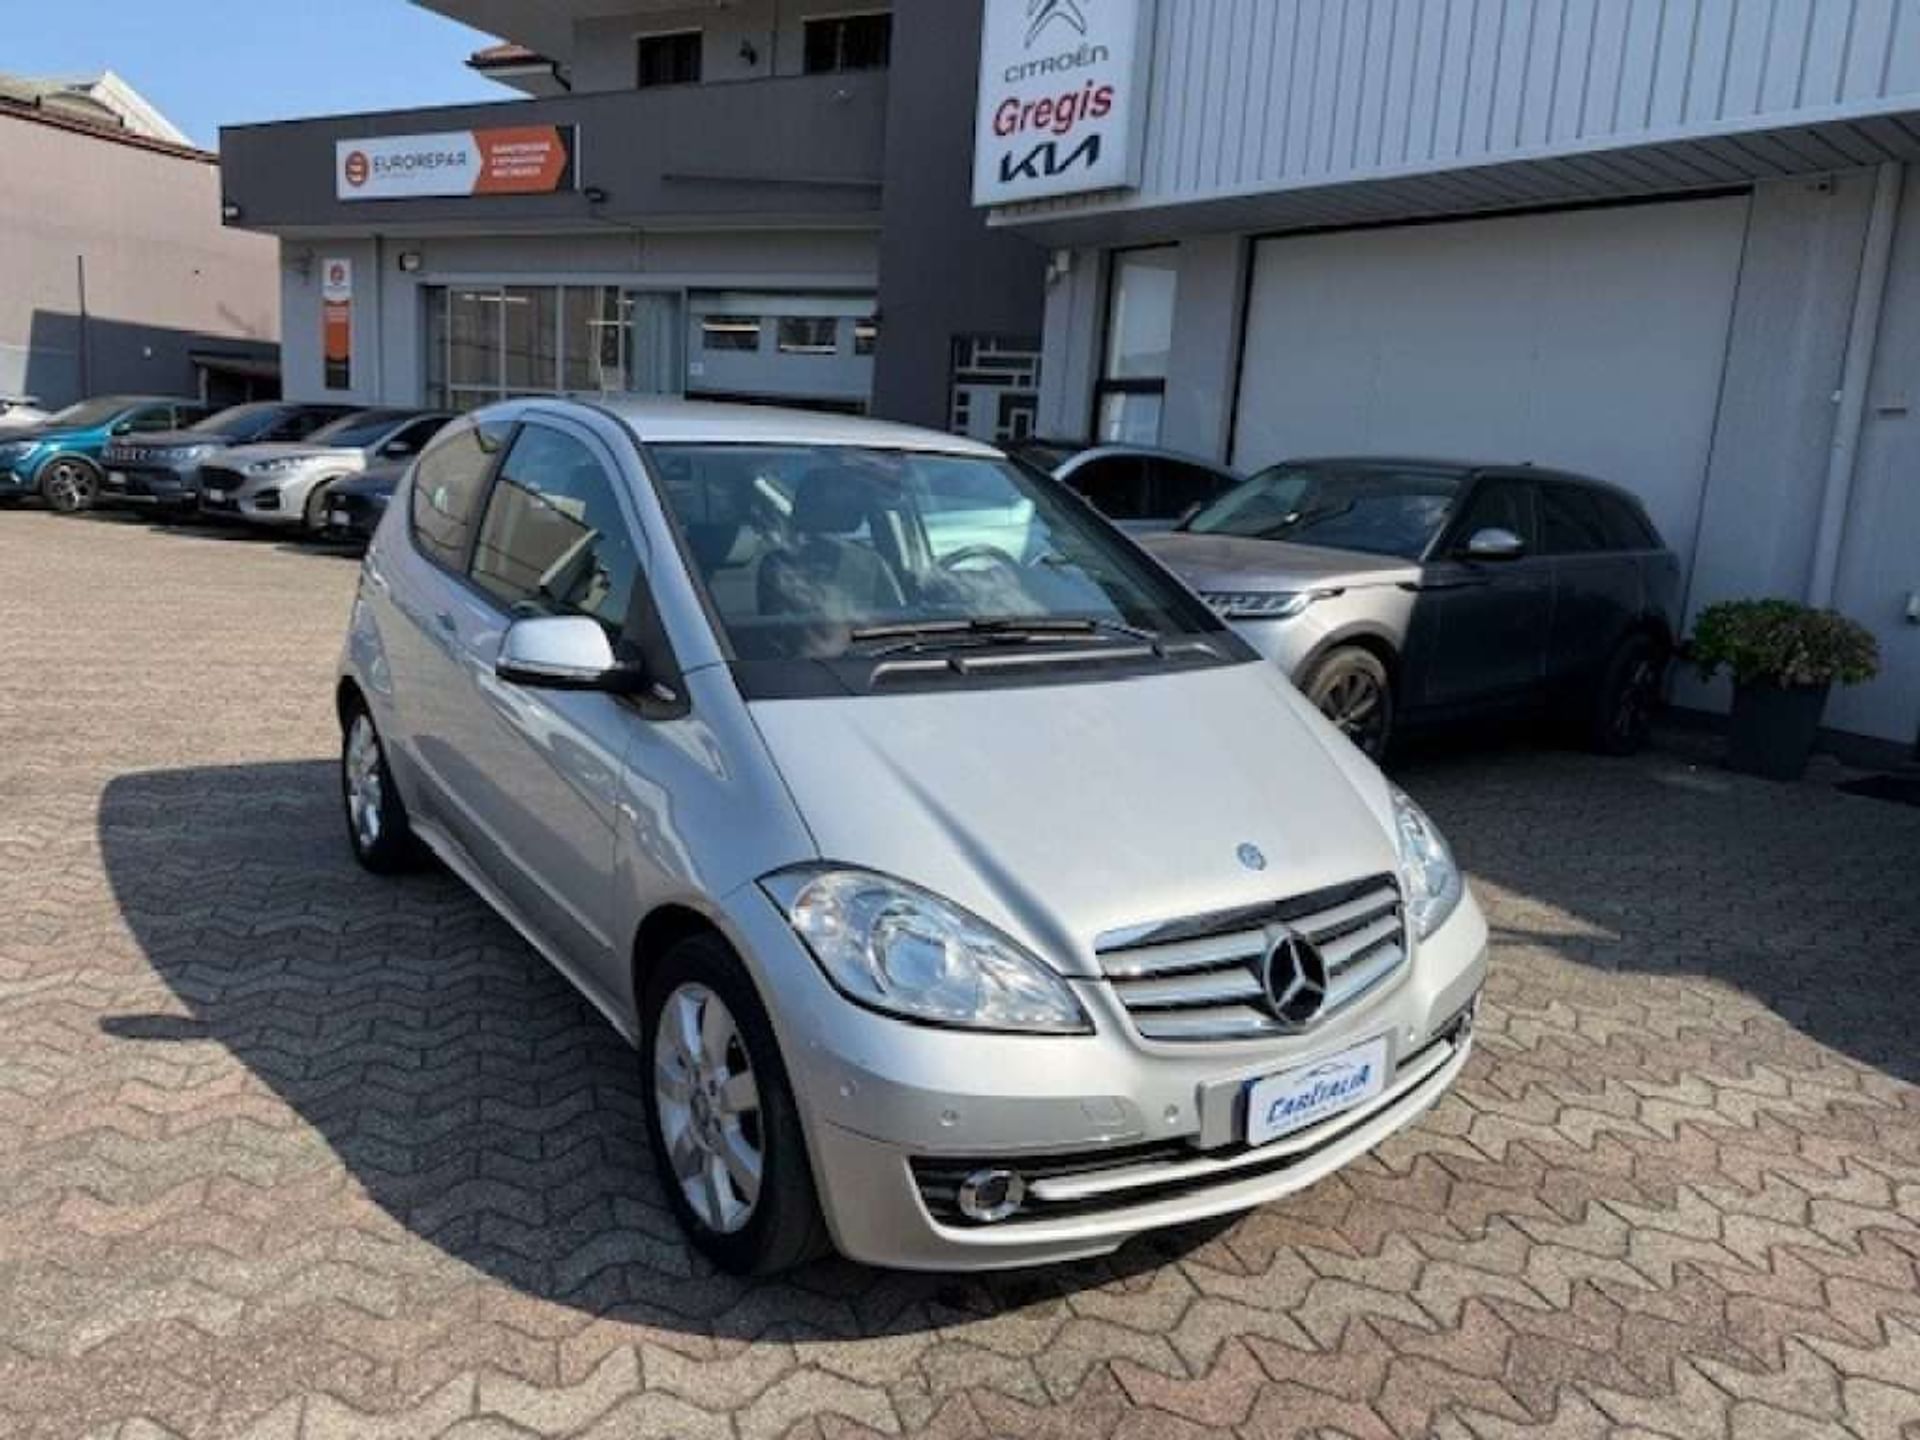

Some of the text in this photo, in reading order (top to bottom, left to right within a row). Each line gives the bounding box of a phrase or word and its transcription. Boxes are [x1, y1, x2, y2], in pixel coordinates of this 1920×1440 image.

[993, 79, 1114, 137] Gregis
[373, 151, 467, 173] EUROREPAR
[999, 134, 1101, 182] KIA
